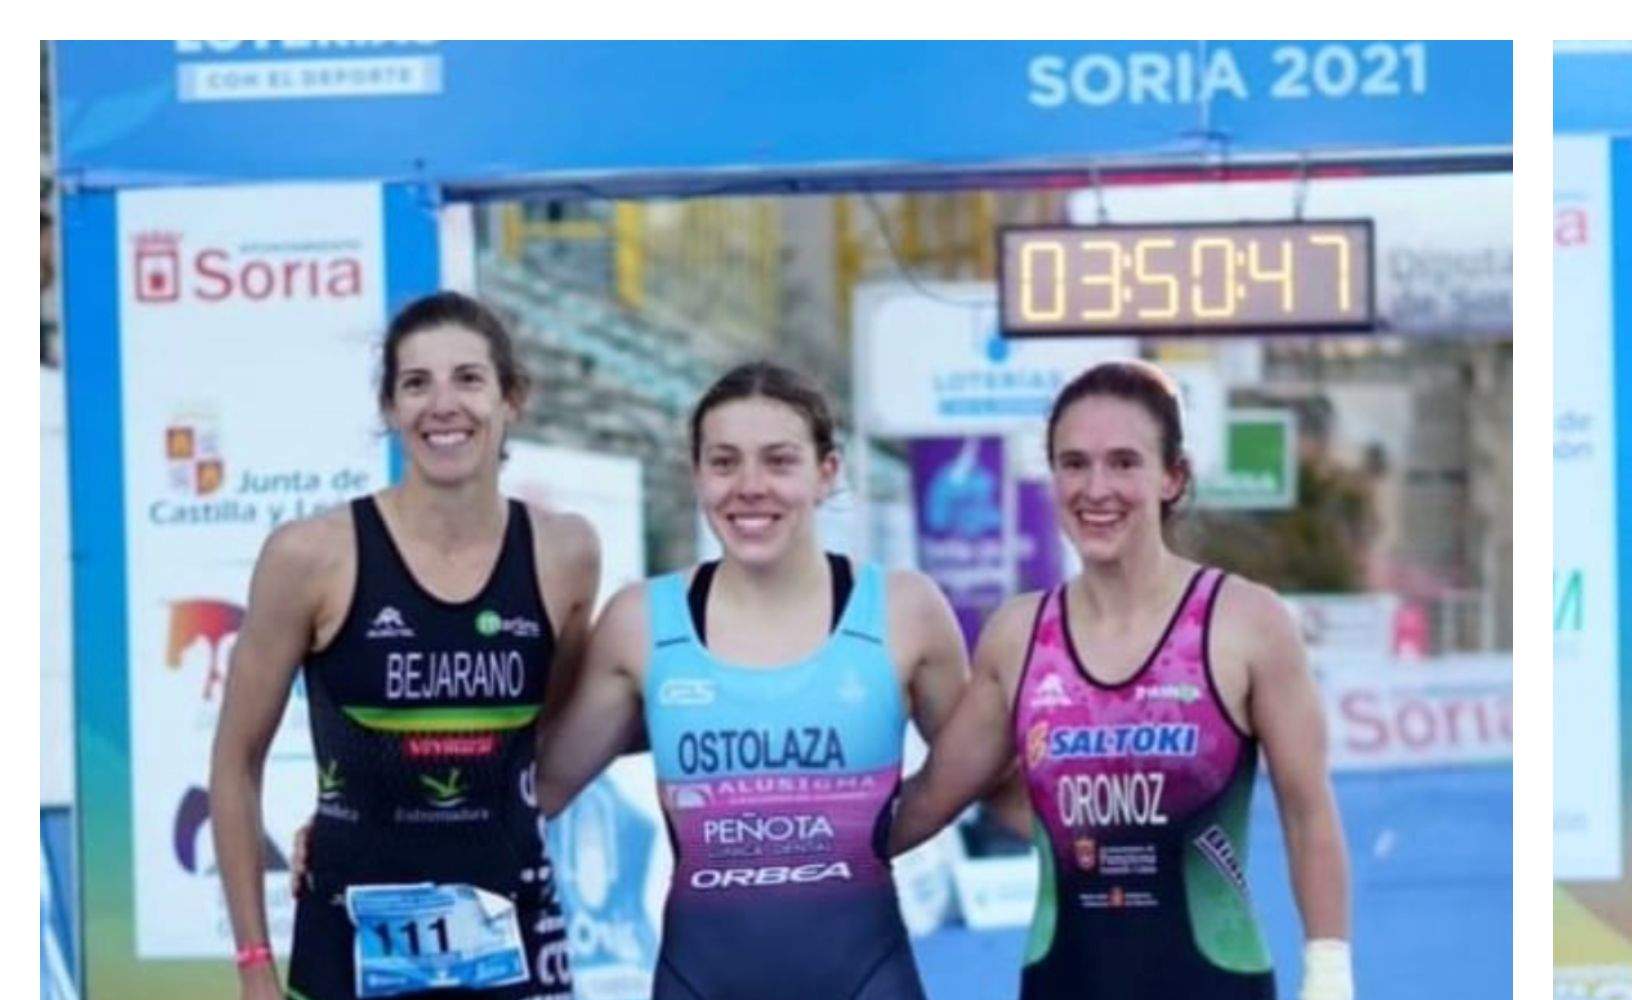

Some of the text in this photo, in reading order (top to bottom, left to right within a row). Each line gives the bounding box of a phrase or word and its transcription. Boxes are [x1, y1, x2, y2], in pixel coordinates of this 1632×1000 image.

[1027, 42, 1428, 107] SORIA 2021
[193, 248, 364, 302] Soria
[1020, 232, 1351, 323] 03:50:47
[237, 469, 369, 495] Junta de
[149, 499, 257, 526] Castilla
[268, 503, 284, 525] y
[386, 650, 525, 700] BEJARANO
[678, 726, 847, 774] OSTOLAZA
[1051, 725, 1197, 757] SALTOKI
[1057, 772, 1169, 828] ORONOZ
[703, 811, 836, 844] PEÑOTA
[689, 860, 853, 891] ORBEA
[374, 916, 450, 957] 111
